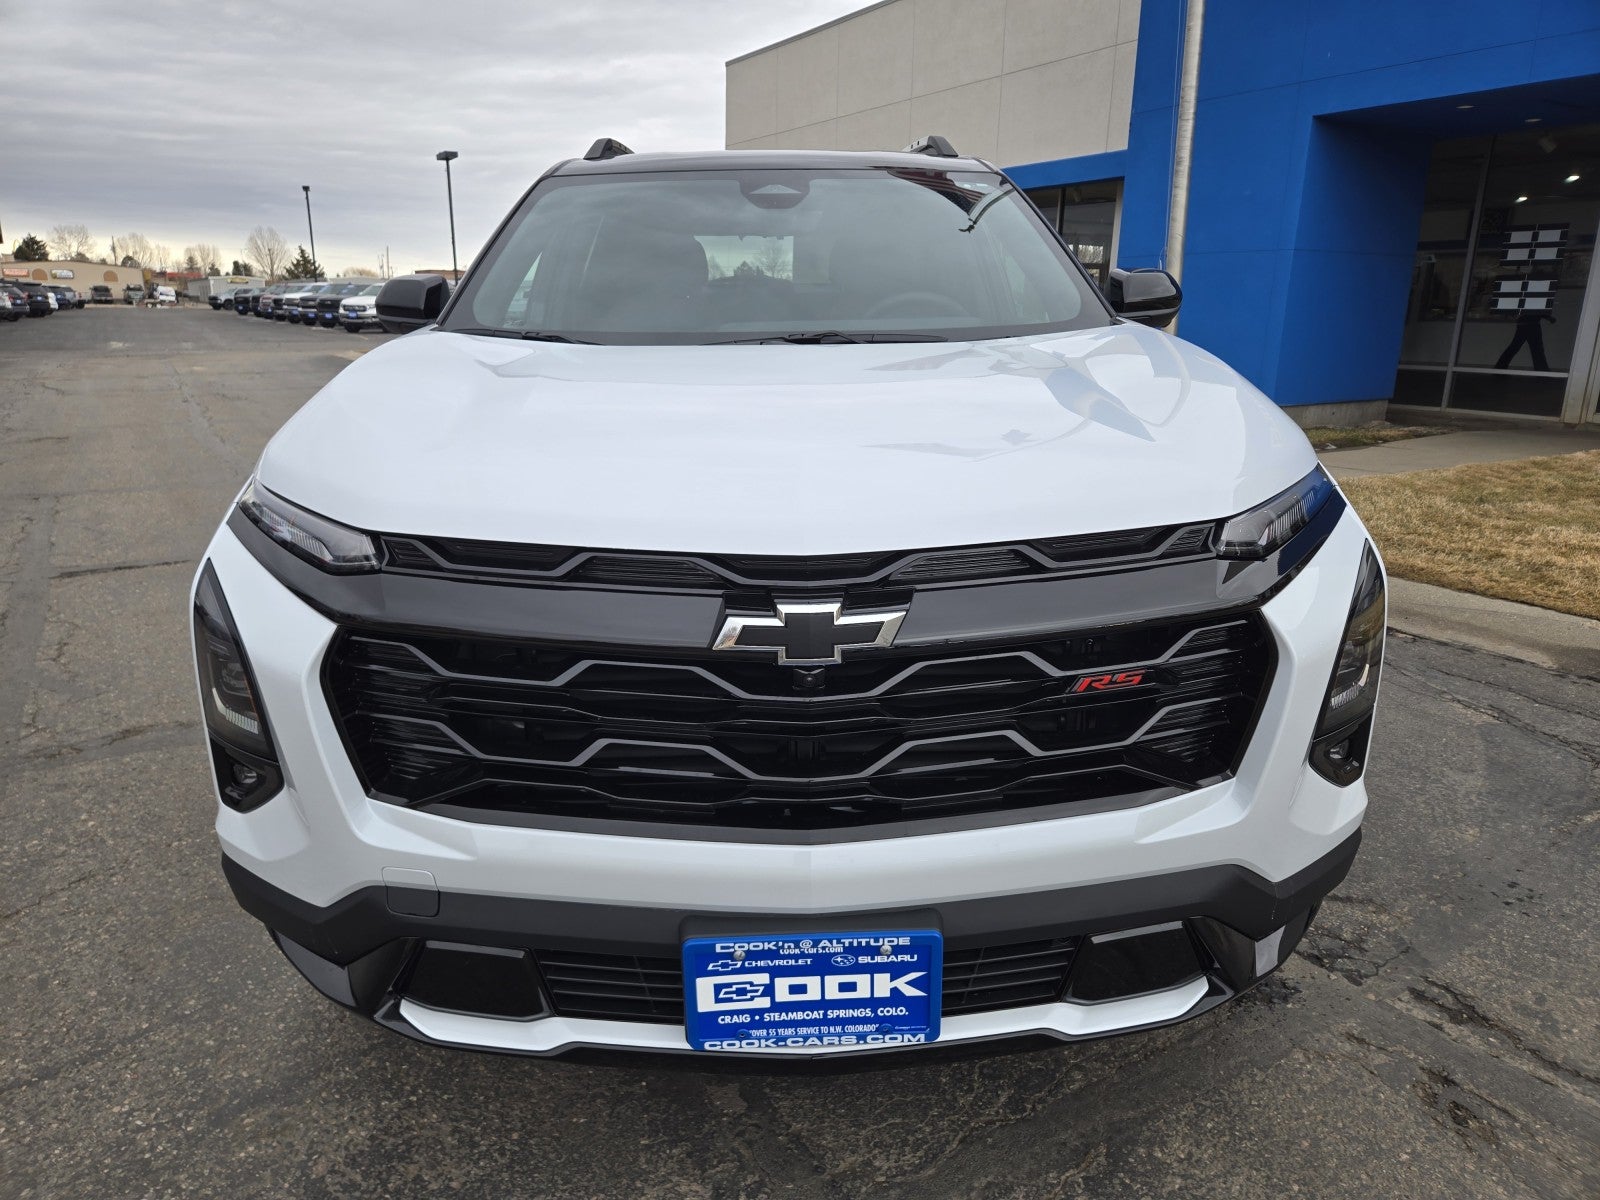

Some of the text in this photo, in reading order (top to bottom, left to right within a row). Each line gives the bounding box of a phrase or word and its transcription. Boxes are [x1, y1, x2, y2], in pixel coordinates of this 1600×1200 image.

[1070, 667, 1147, 693] RS
[799, 939, 813, 949] @
[817, 937, 911, 947] ALTITUDE
[744, 958, 813, 967] CHEVROLET
[857, 954, 917, 963] SUBARU
[695, 971, 928, 1013] COOK
[717, 1007, 909, 1024] CRAIG STEAMBOAT SPRINGS, COLO.
[769, 1028, 776, 1036] 55
[777, 1027, 796, 1036] YEARS
[796, 1026, 819, 1035] SERVICE
[821, 1025, 829, 1034] TO
[829, 1025, 843, 1033] N.W.
[703, 1033, 926, 1050] COOK-CARS.COM
